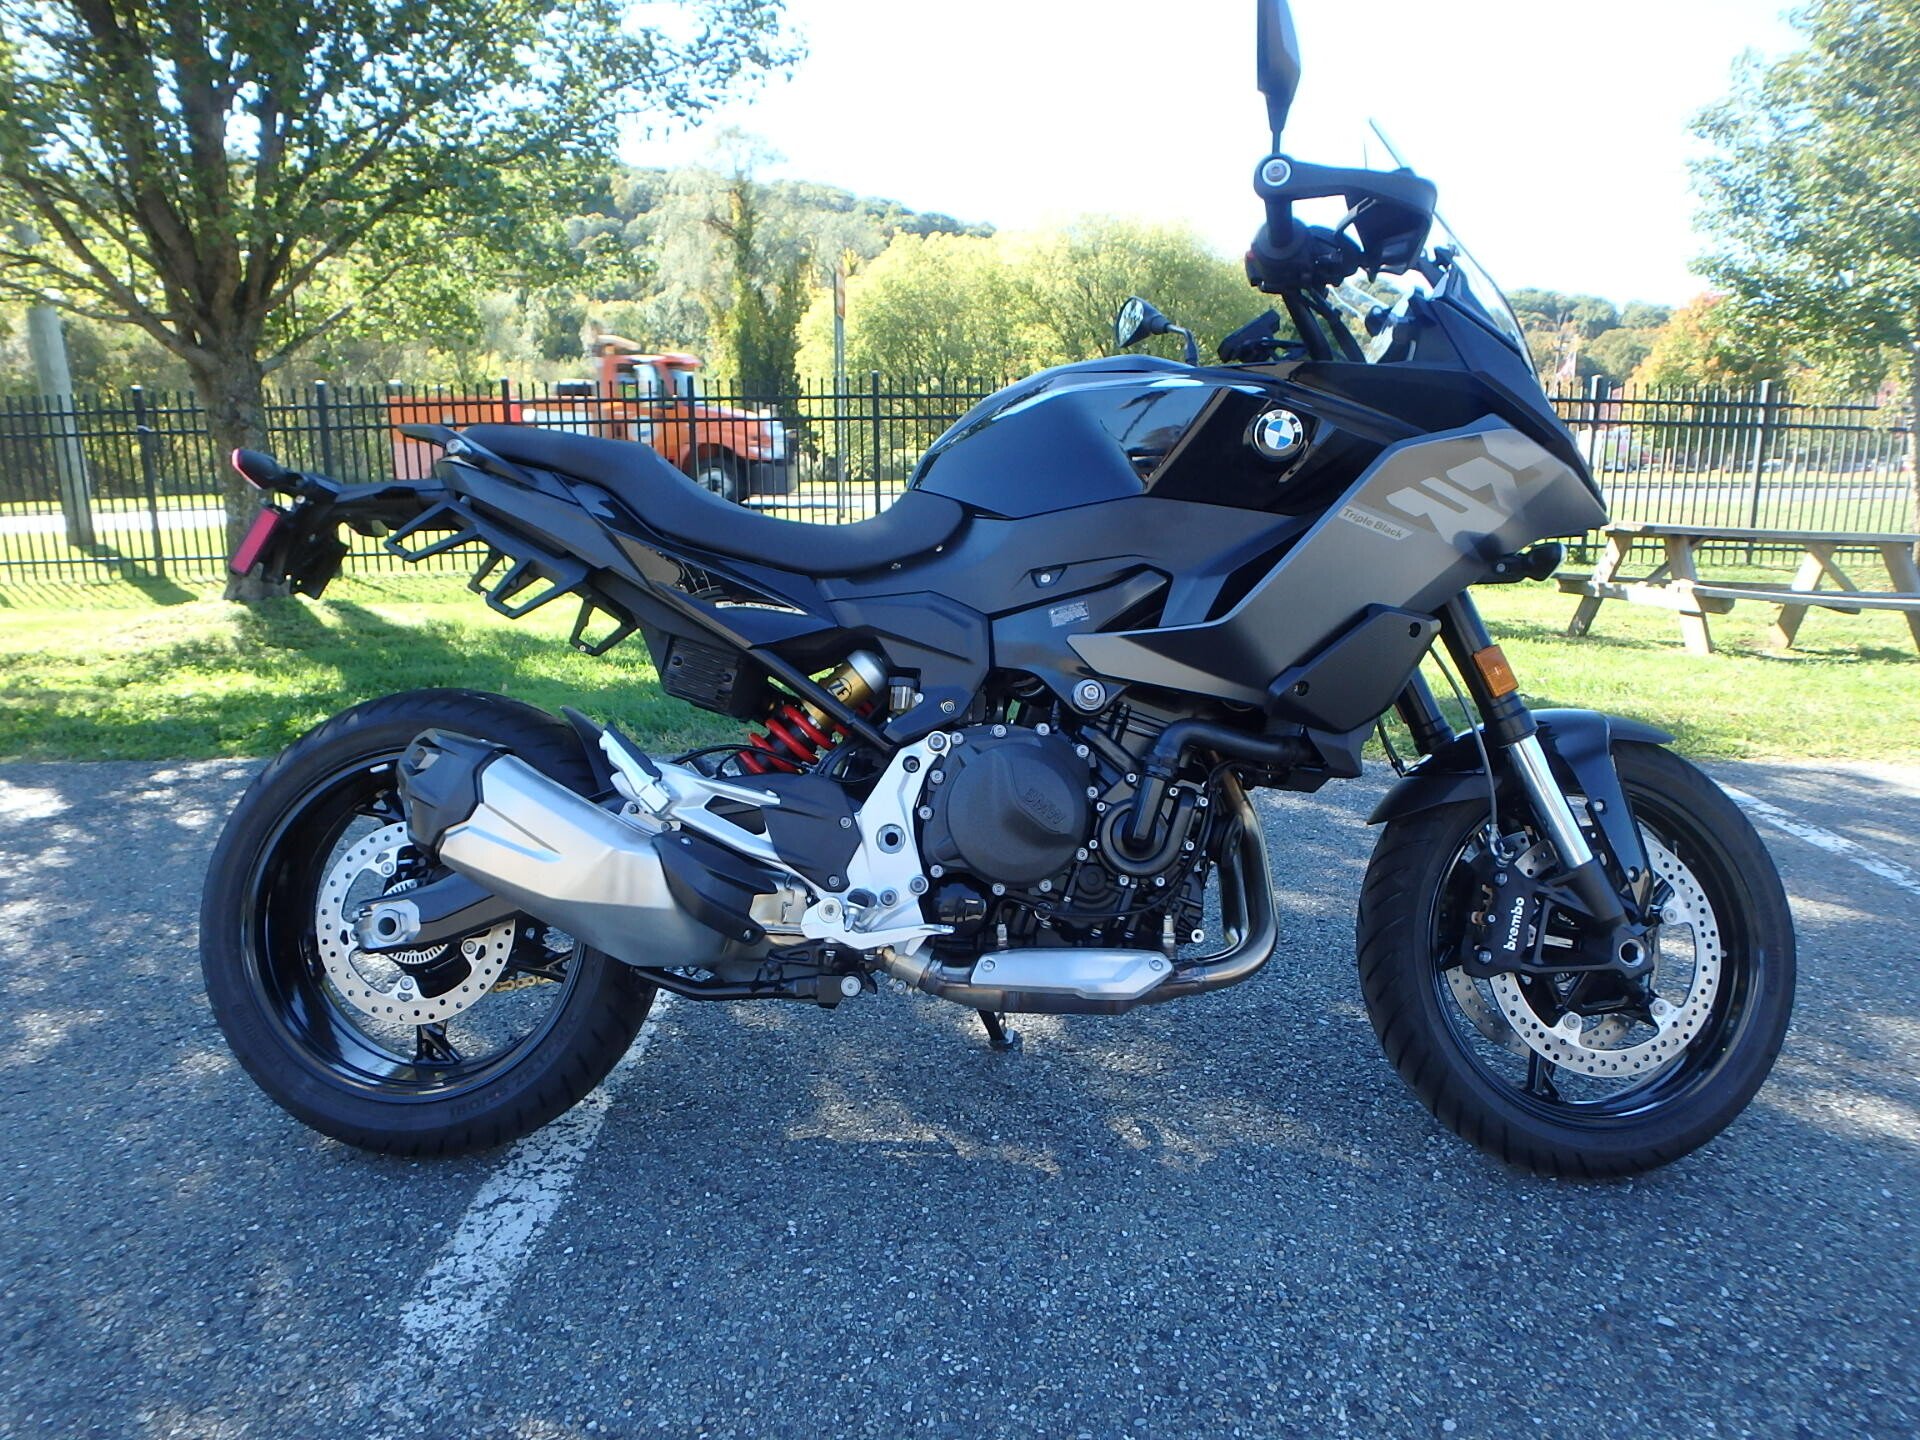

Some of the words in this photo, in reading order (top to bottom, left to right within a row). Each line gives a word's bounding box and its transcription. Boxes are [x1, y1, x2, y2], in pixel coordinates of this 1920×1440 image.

[1343, 508, 1374, 527] Triple
[1374, 520, 1402, 539] Black
[1503, 896, 1526, 951] brembo
